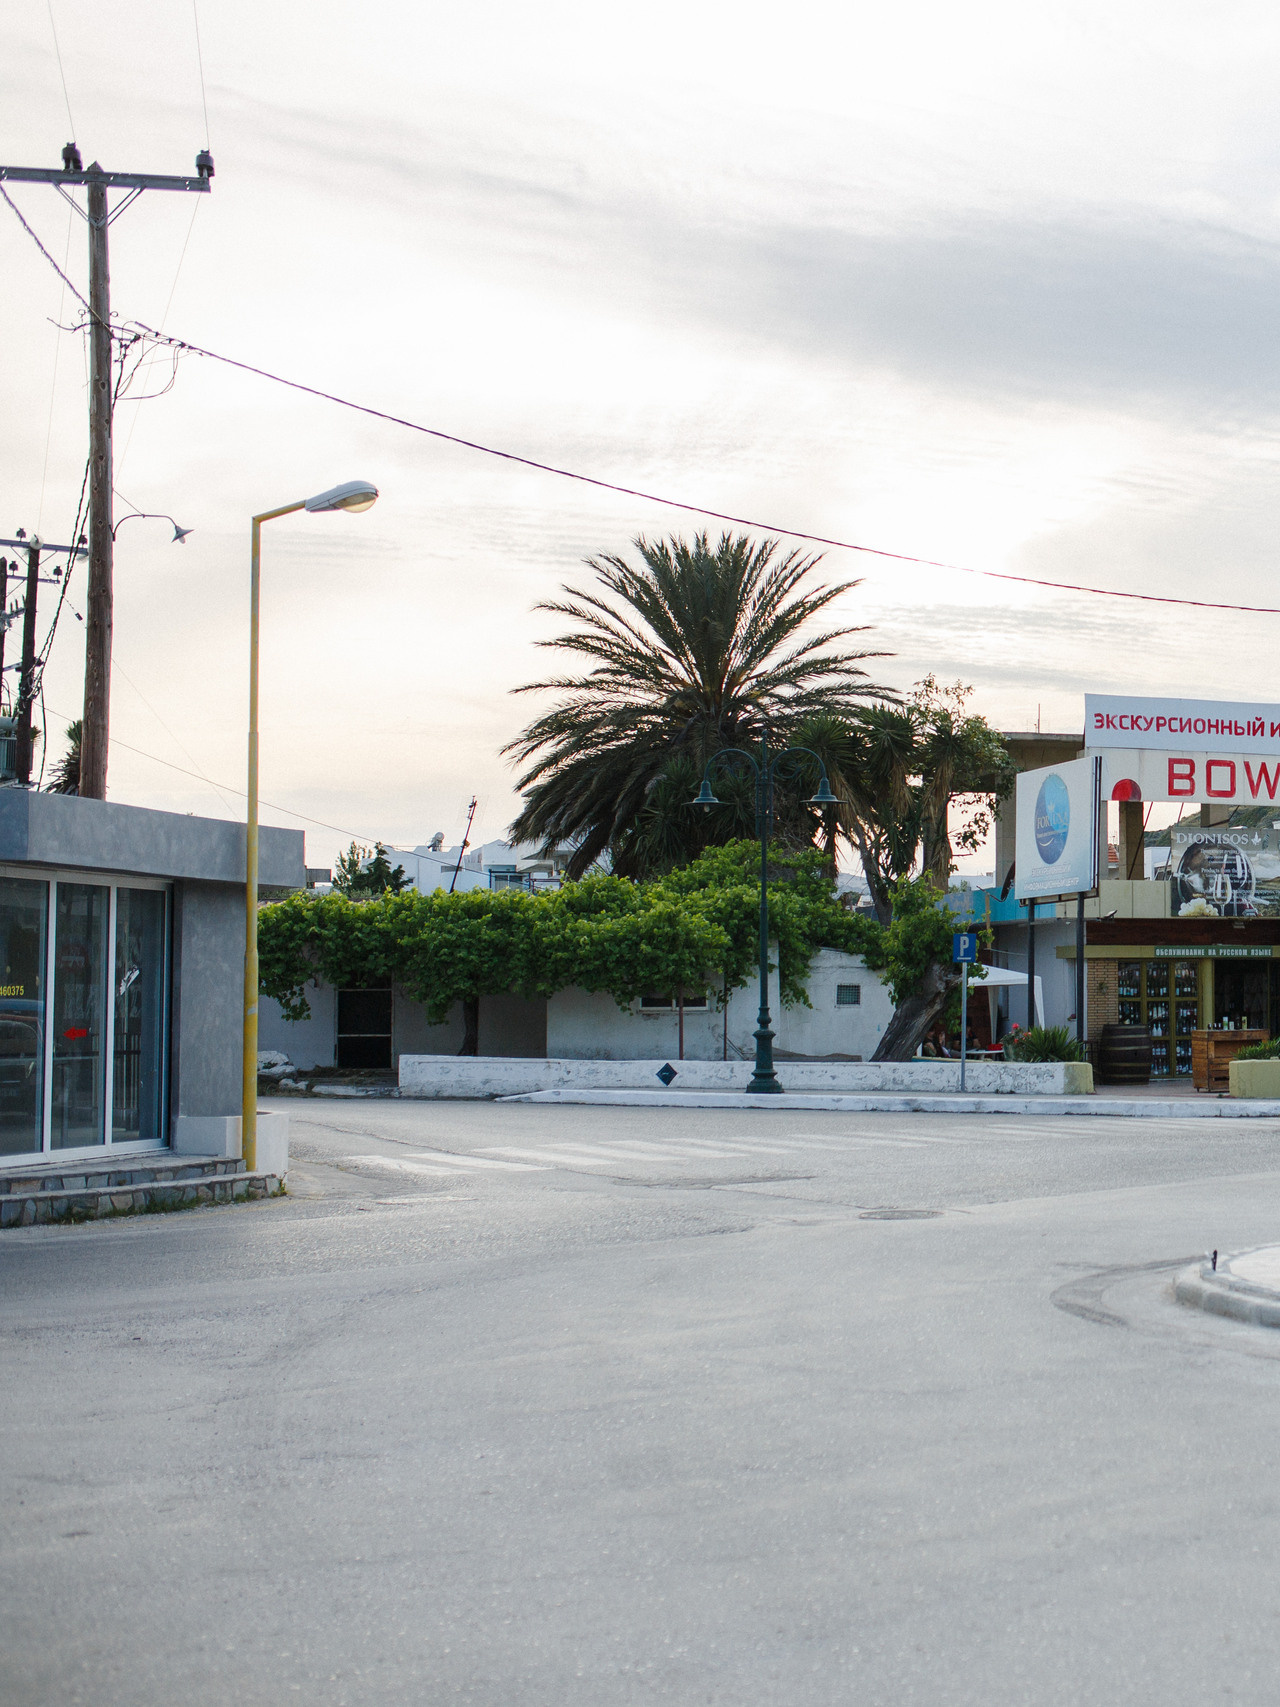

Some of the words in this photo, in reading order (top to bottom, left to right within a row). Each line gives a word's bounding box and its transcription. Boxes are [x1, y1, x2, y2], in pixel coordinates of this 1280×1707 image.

[1093, 713, 1265, 738] ЭКСКУРСИОННЫЙ
[1176, 832, 1249, 845] DIONISOS
[959, 936, 970, 957] P
[1155, 948, 1205, 956] ОБСЛУЖИВАНИЕ
[1208, 948, 1217, 956] НА
[1219, 948, 1248, 956] РУССКОМ
